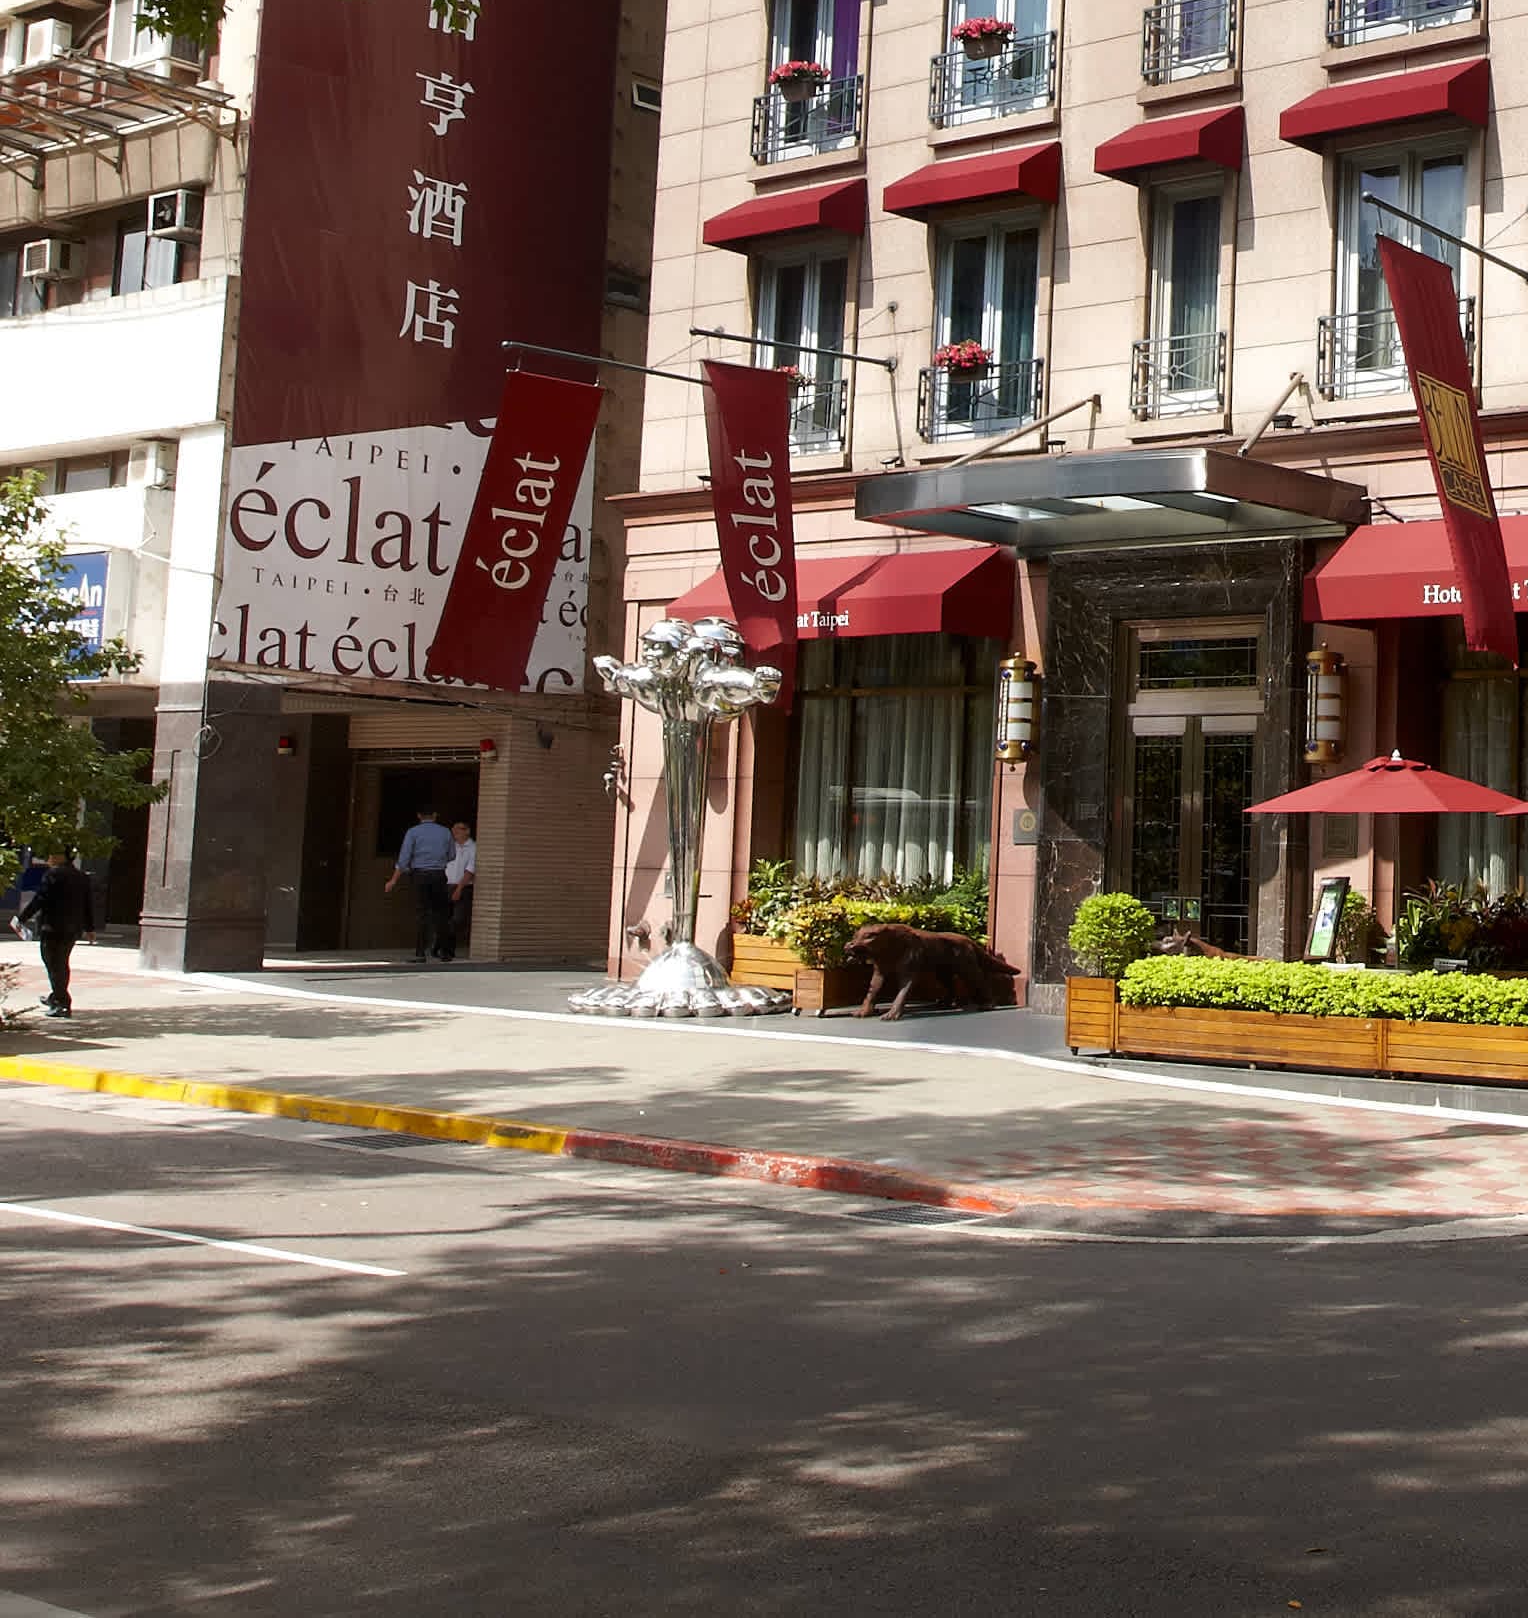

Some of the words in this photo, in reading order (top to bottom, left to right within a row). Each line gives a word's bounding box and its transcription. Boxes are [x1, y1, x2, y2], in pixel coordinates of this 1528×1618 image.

[230, 461, 452, 577] éclat
[476, 451, 561, 590] éclat
[730, 448, 788, 602] éclat
[252, 566, 350, 596] TAIPEI
[383, 584, 426, 606] 台北
[810, 610, 849, 631] Taipei
[1423, 584, 1463, 604] Hot
